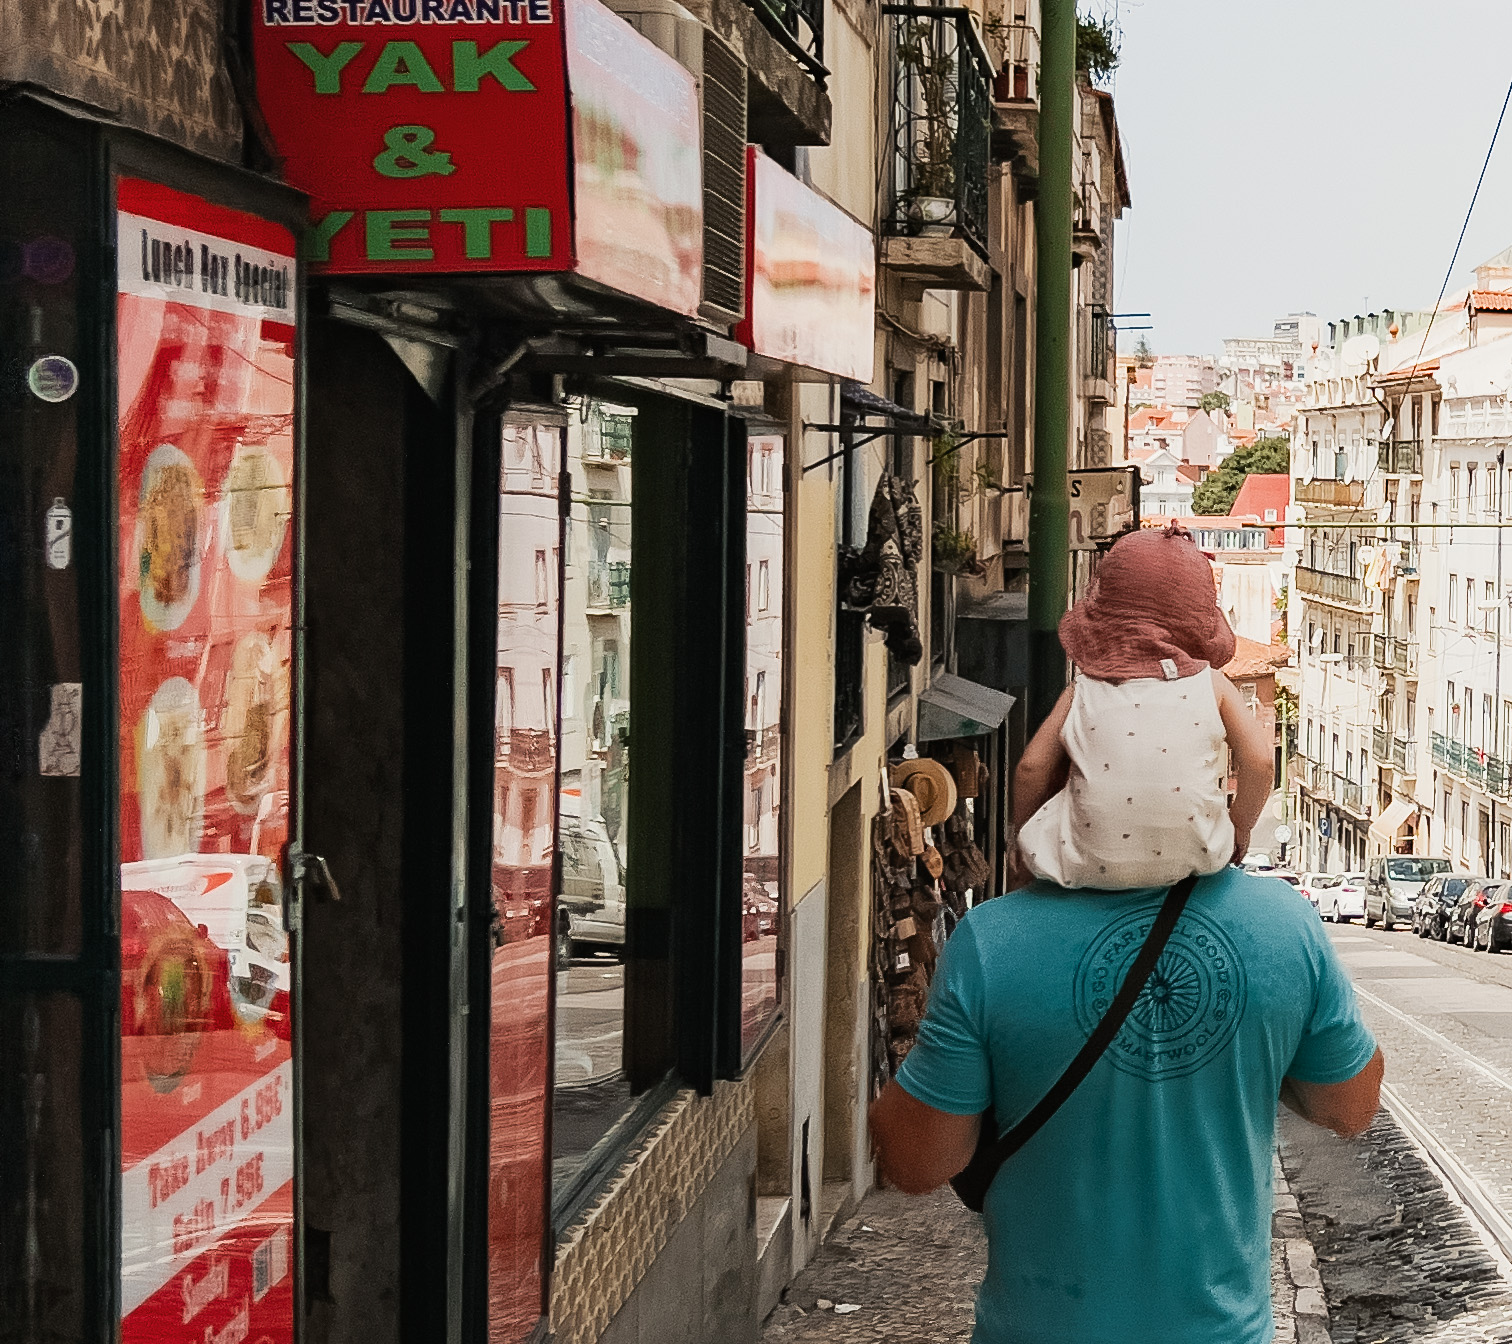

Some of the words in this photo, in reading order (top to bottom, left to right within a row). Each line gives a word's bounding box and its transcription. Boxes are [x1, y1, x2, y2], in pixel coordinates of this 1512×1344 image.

[286, 40, 537, 94] YAK
[373, 124, 456, 178] &
[304, 208, 551, 262] YETI
[141, 228, 194, 291] Lunch
[234, 253, 288, 309] Special
[1103, 931, 1137, 964] FAR
[1195, 934, 1229, 984] GOOD
[1113, 1024, 1221, 1061] MARTWOOL
